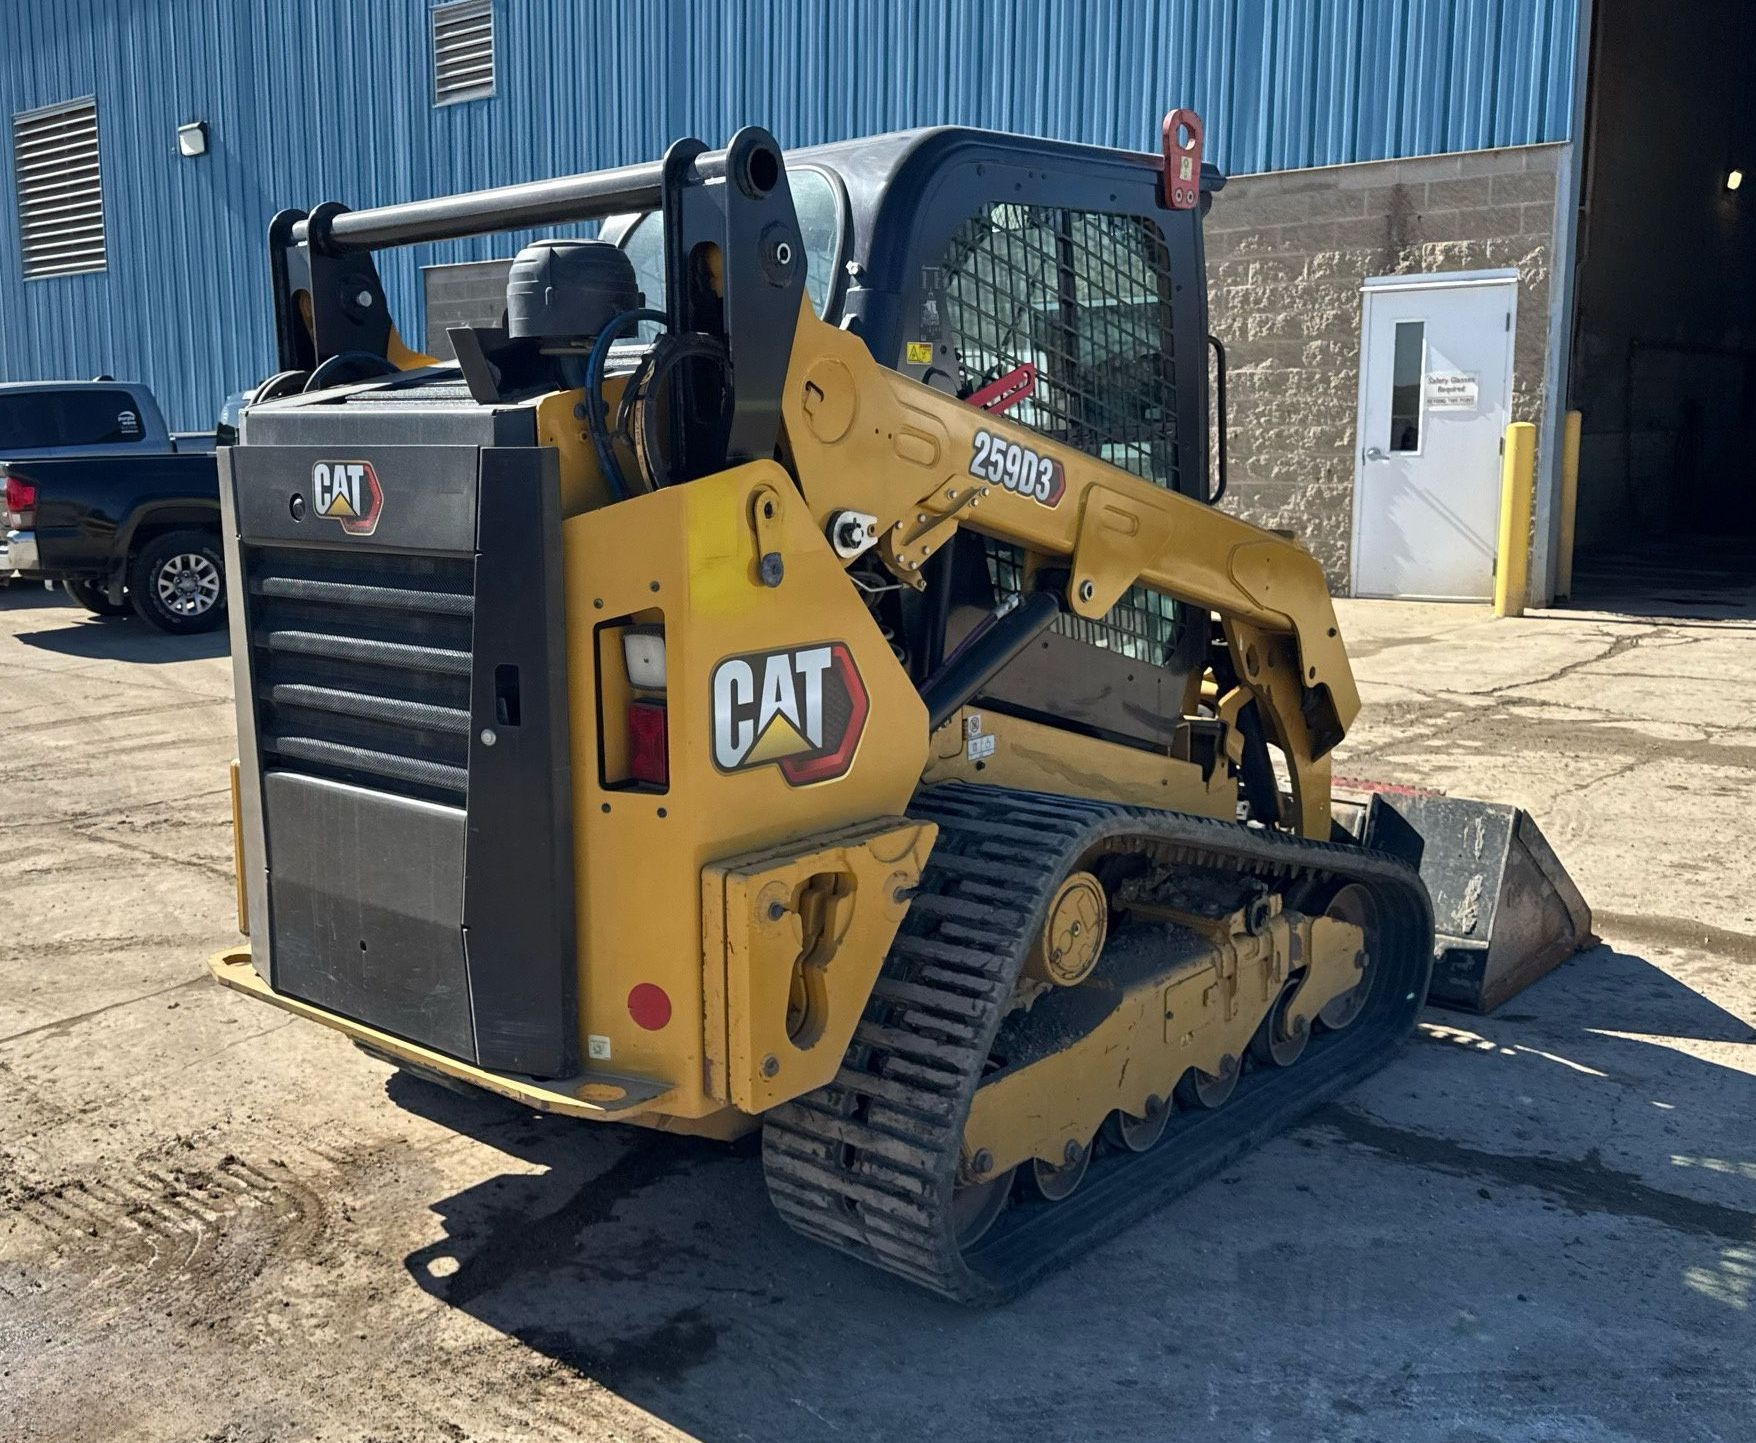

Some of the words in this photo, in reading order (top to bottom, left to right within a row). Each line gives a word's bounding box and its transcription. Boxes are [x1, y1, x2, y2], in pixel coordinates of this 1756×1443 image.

[1437, 385, 1466, 394] Required
[1450, 376, 1476, 384] Glasses
[314, 463, 364, 516] CAT
[970, 431, 1053, 501] 259D3
[714, 647, 832, 768] CAT
